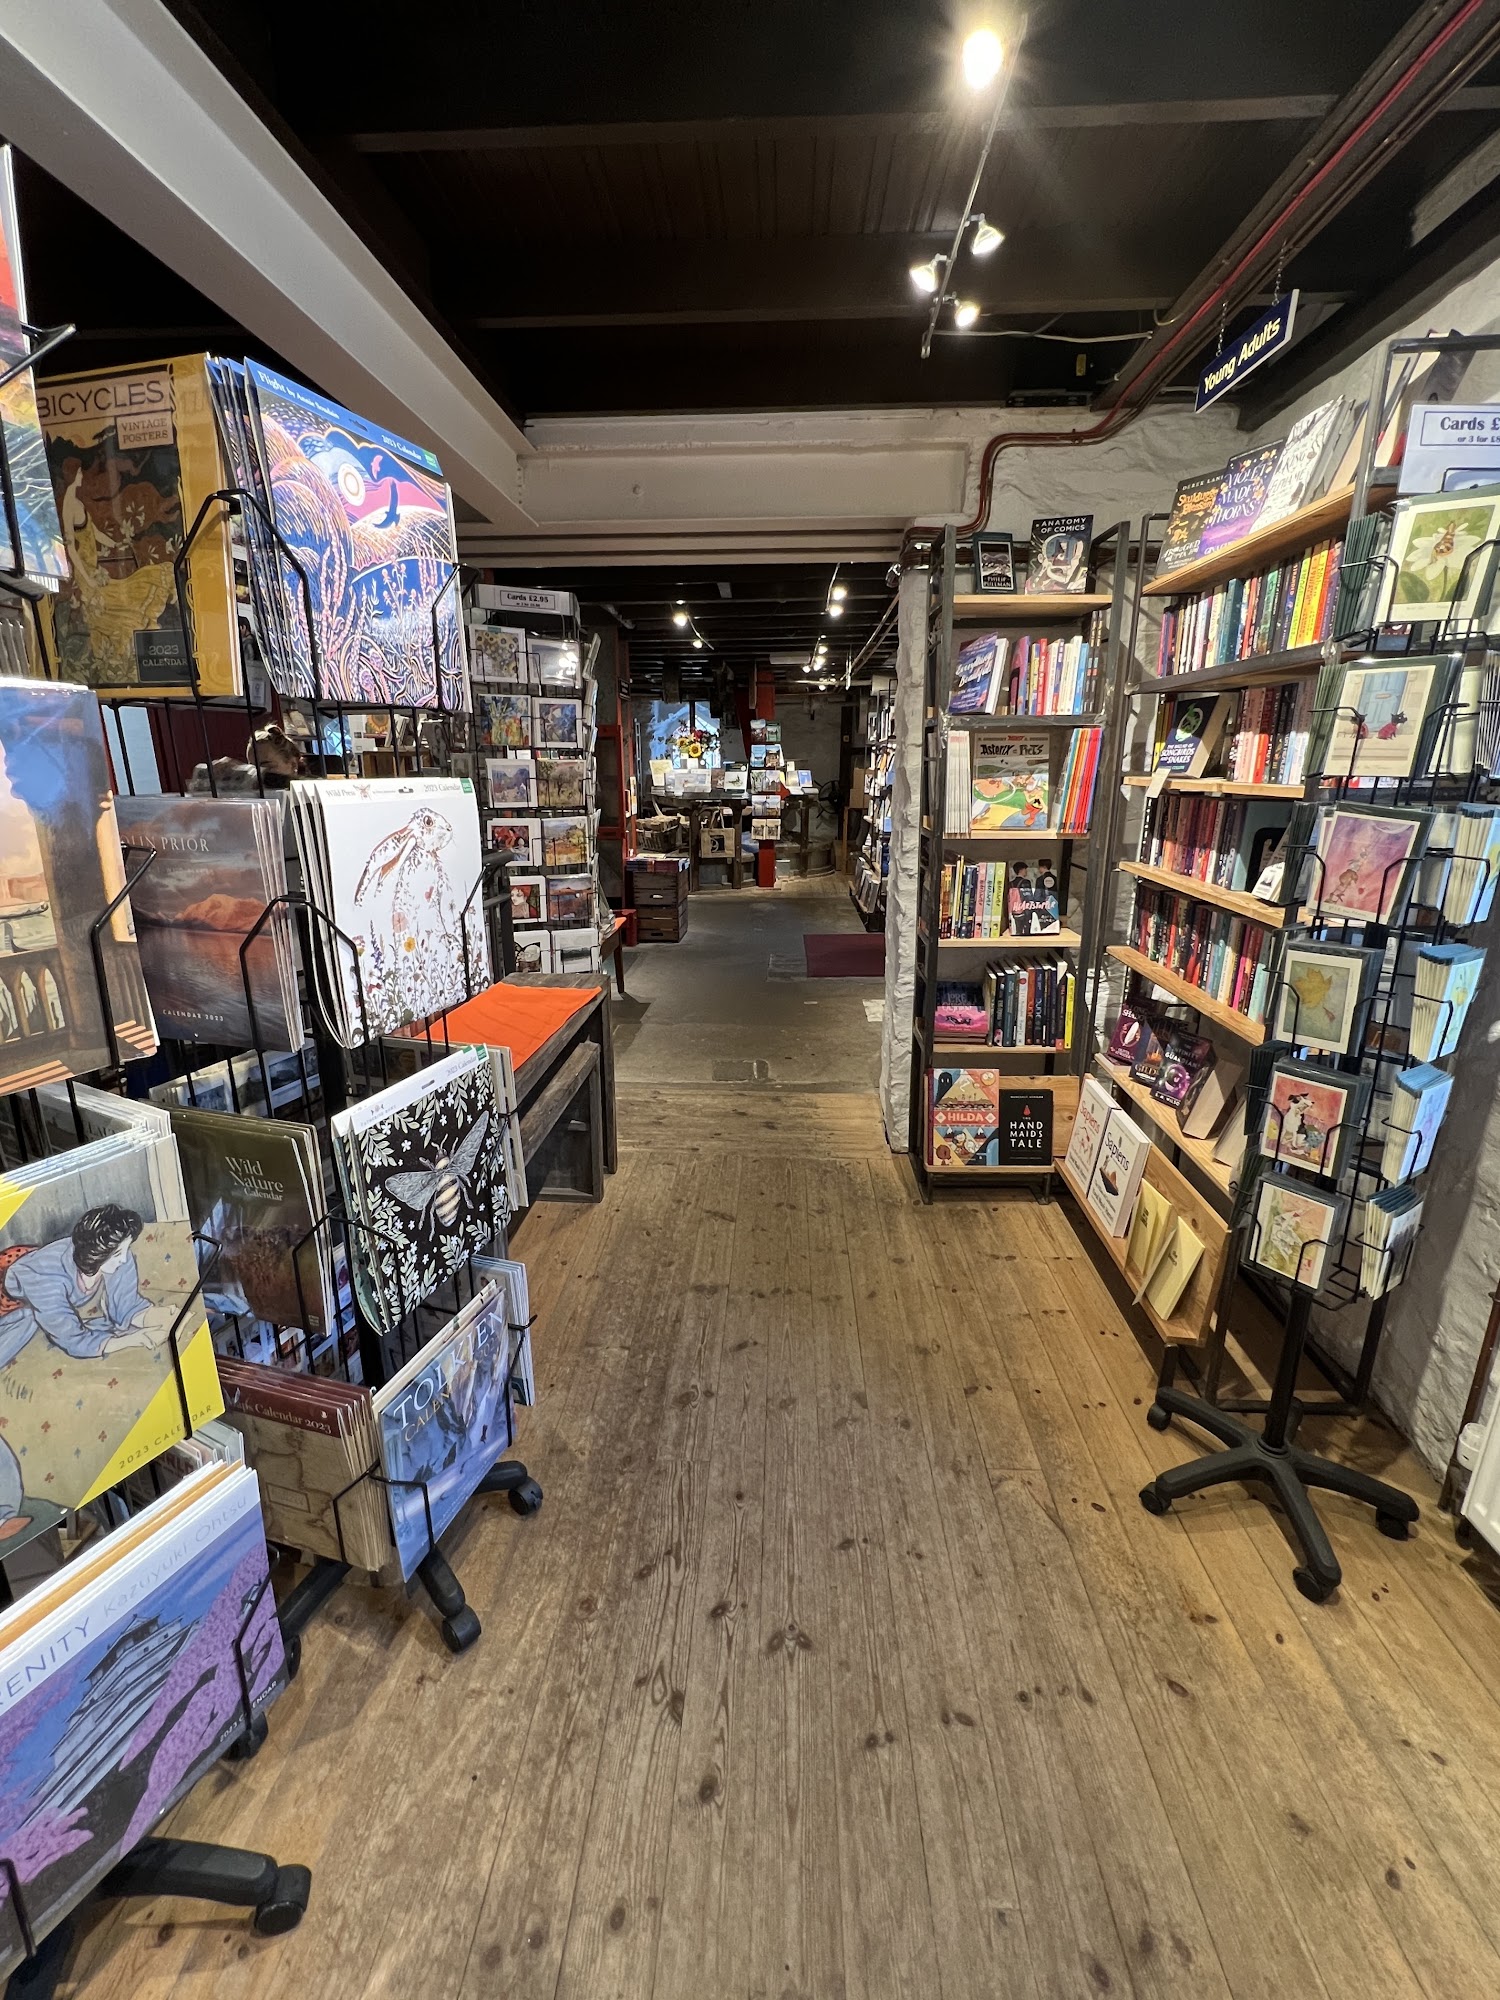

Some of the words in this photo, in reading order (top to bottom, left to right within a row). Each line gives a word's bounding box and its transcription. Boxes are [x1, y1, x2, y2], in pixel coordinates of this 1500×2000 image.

[1204, 356, 1236, 394] Young
[1237, 317, 1281, 367] Adults
[37, 380, 164, 419] BICYCLES
[121, 417, 168, 432] VINTAGE
[1440, 416, 1485, 431] Cards
[122, 429, 168, 444] POSTERS
[1468, 435, 1474, 443] 3
[1476, 435, 1488, 443] for
[1182, 480, 1205, 491] DEREK
[1040, 517, 1087, 528] ANATOMY
[1053, 523, 1086, 534] COMICS
[507, 592, 527, 602] Cards
[148, 644, 179, 656] 2023
[142, 657, 188, 668] CALENDAR
[1160, 747, 1195, 757] SONGBIRDS
[1167, 755, 1192, 764] SNAKES
[325, 788, 341, 798] Wild
[423, 783, 439, 793] 2023
[438, 782, 461, 793] Calendar
[120, 834, 157, 850] OLIN
[160, 836, 210, 852] PRIOR
[162, 1009, 202, 1019] CALENDAR
[205, 1013, 224, 1022] 2023
[947, 1112, 985, 1122] HILDA
[1079, 1100, 1101, 1134] Sapiens
[1009, 1121, 1043, 1130] HAND
[1010, 1138, 1042, 1149] TALE
[1104, 1131, 1131, 1172] Sapiens
[225, 1156, 264, 1176] Wild
[229, 1170, 284, 1193] Nature
[244, 1188, 284, 1201] Calendar
[394, 1311, 503, 1431] TOLKIEN
[255, 1403, 302, 1425] Calendar
[304, 1419, 332, 1435] 2023
[119, 1445, 149, 1469] 2023
[153, 1404, 212, 1446] CALEDAR
[0, 1616, 90, 1706] ENITY
[195, 1496, 248, 1543] Ohtsu
[219, 1721, 238, 1743] 2023
[238, 1680, 278, 1722] CENDAR
